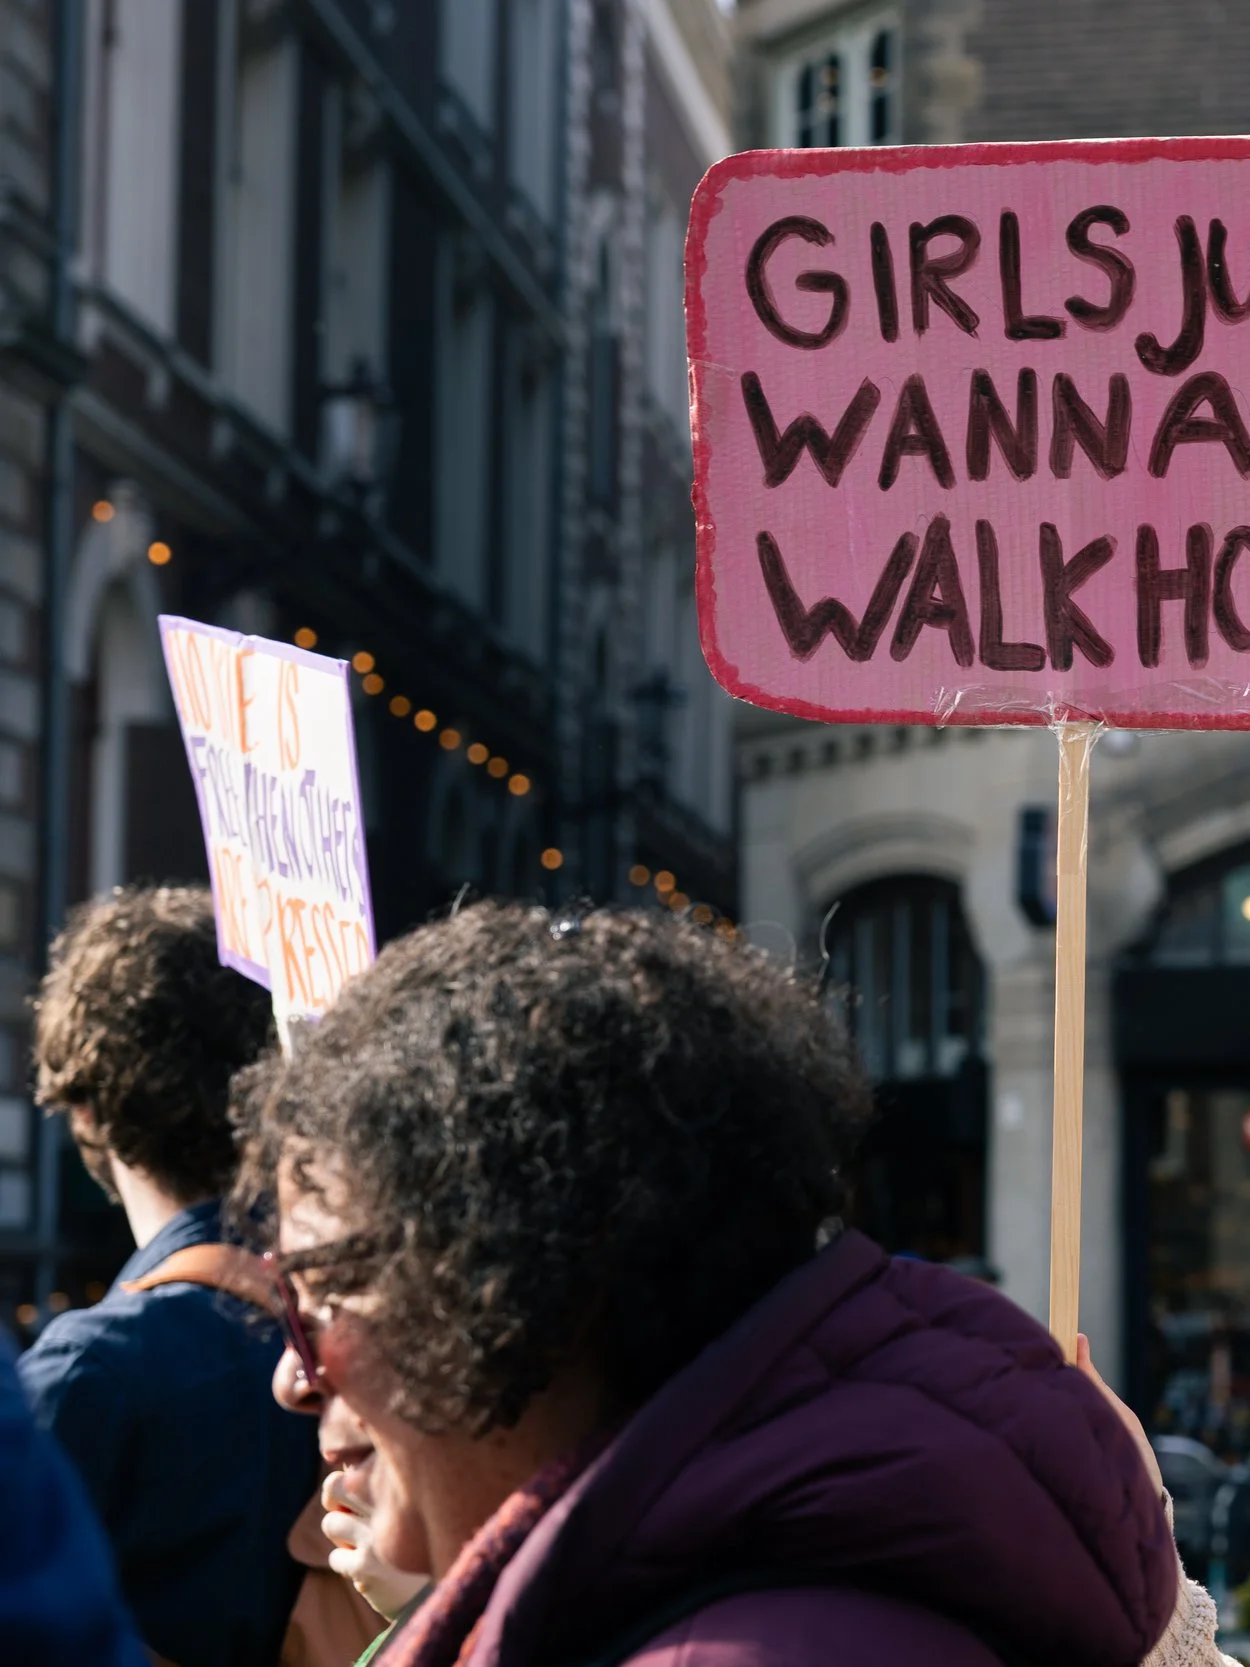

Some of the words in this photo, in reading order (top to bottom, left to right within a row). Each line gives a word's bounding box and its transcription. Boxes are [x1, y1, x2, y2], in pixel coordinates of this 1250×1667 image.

[745, 206, 1136, 349] GIRLS
[756, 512, 1120, 671] WALK
[277, 658, 300, 772] IS
